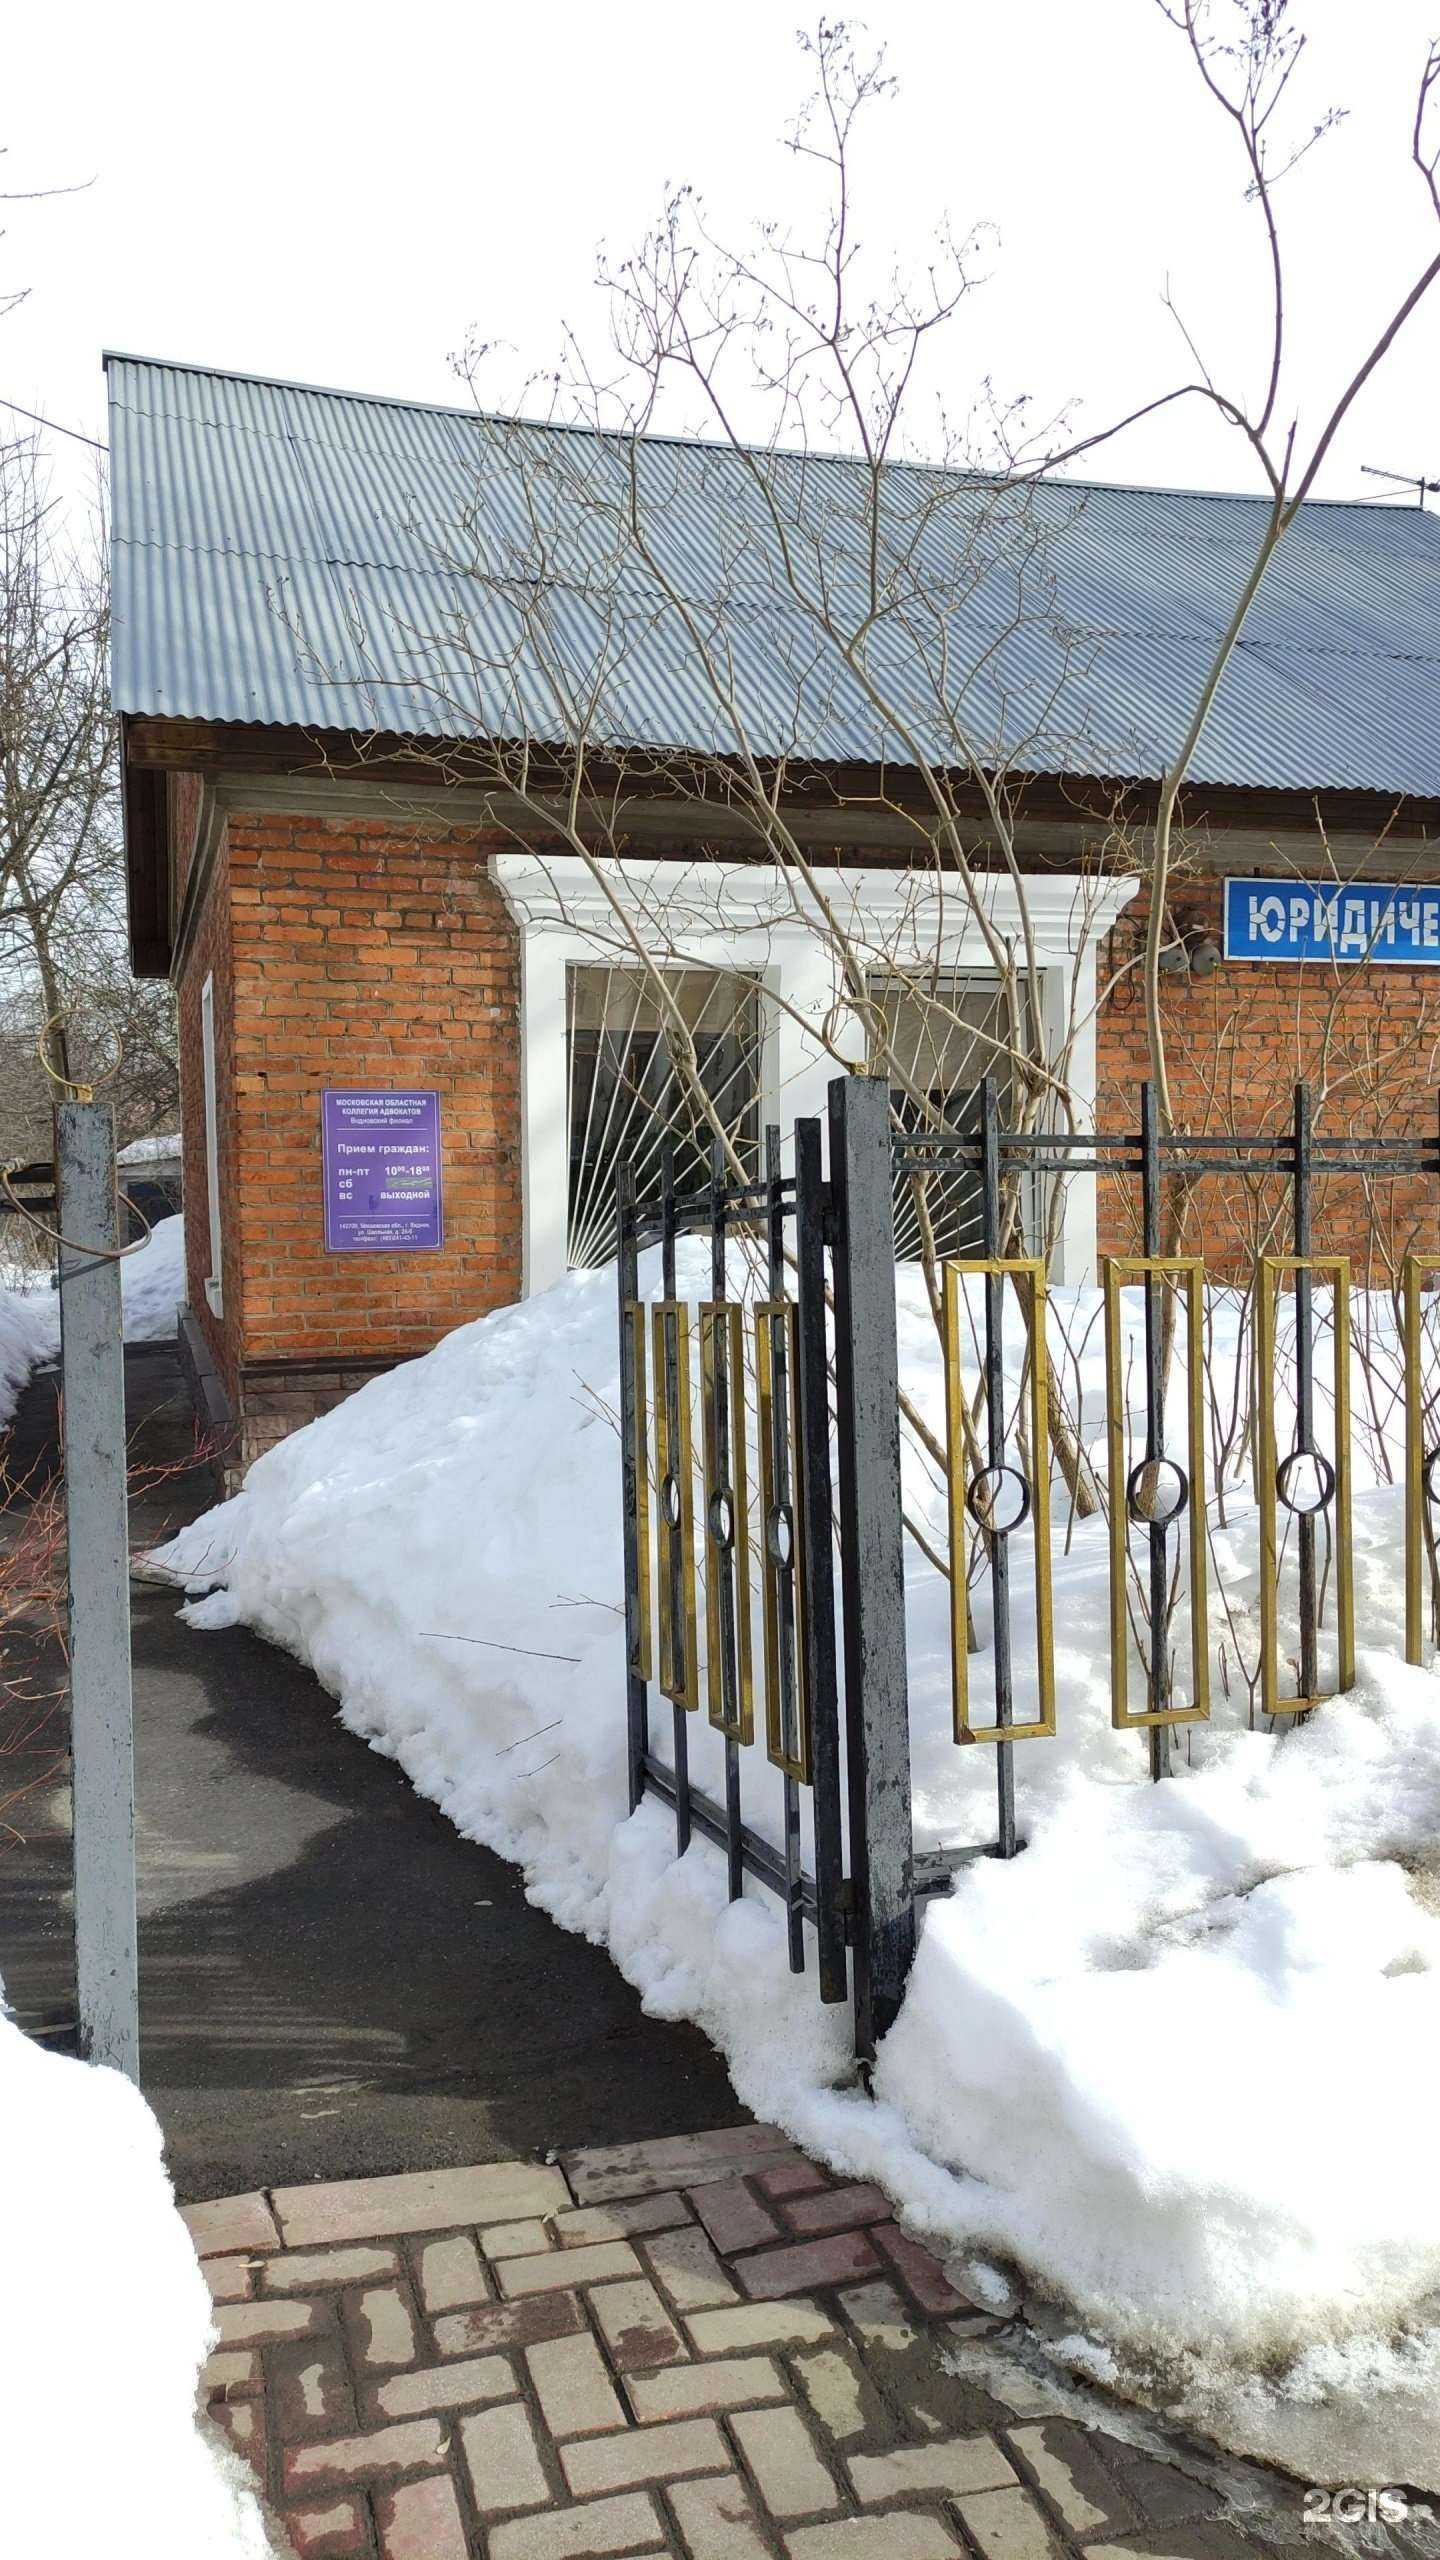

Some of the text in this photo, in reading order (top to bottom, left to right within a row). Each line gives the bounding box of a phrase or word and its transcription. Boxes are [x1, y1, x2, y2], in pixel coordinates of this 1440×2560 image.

[342, 1107, 421, 1116] КОЛЛЕГИЯ АДВОКАТОВ
[337, 1144, 429, 1155] Прием граждан:
[338, 1168, 370, 1176] пн-пт
[338, 1179, 353, 1188] сб
[338, 1190, 430, 1200] вс выходной
